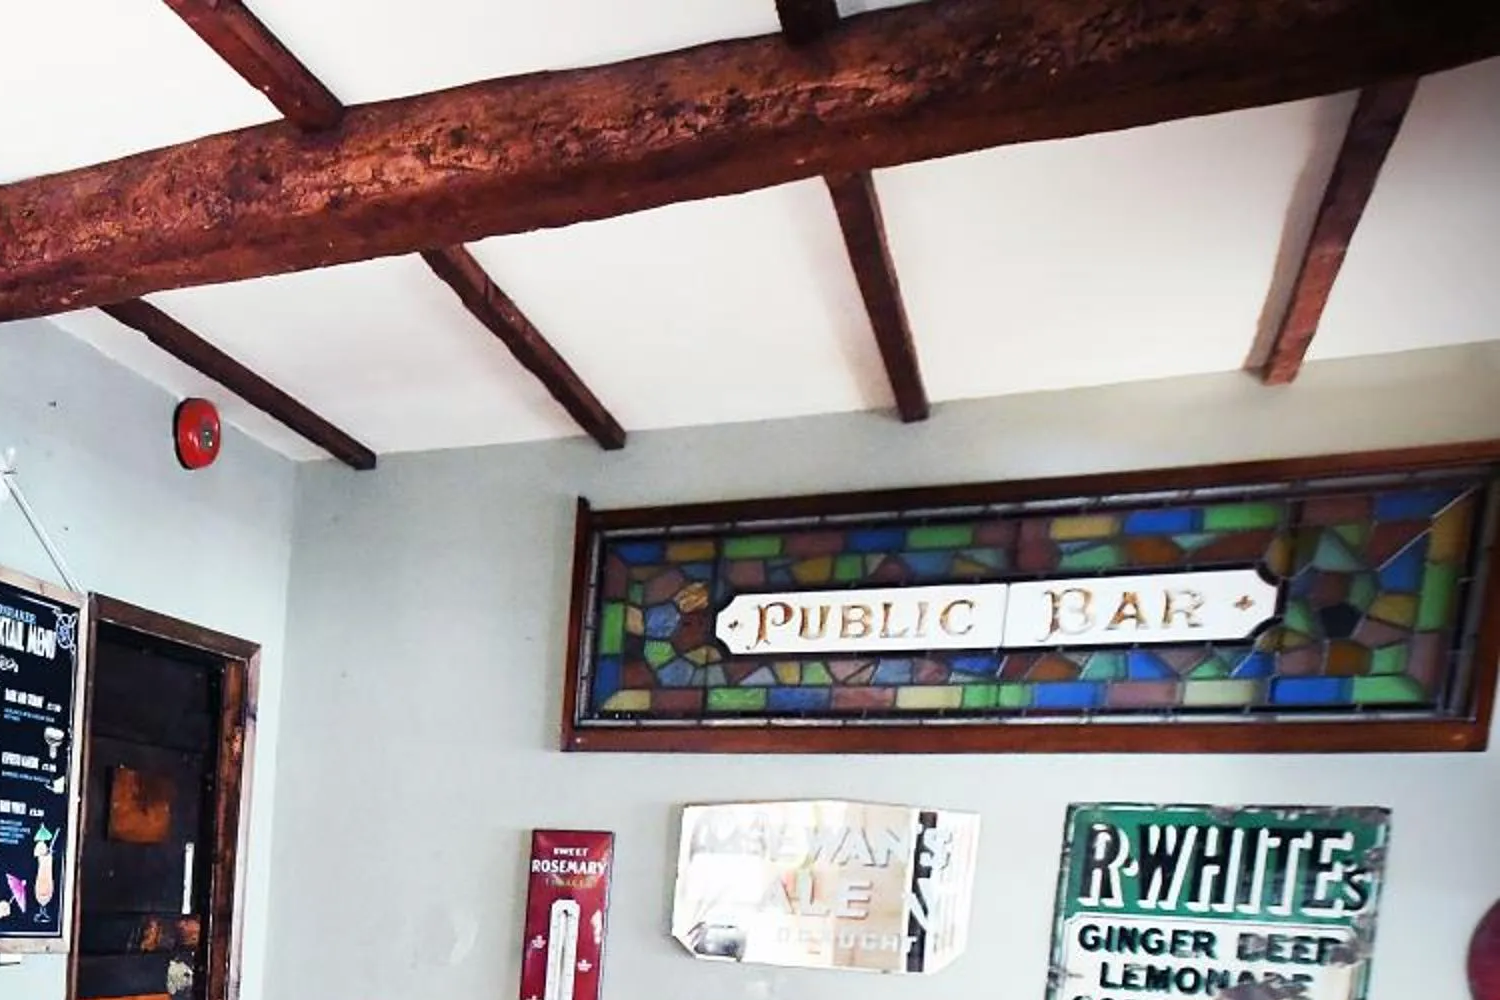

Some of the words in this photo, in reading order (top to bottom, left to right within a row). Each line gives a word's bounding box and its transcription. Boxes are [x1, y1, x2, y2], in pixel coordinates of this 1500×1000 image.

[746, 599, 977, 650] PUBLIC
[1035, 587, 1206, 643] BAR
[531, 859, 608, 876] ROSEMARY
[1077, 923, 1219, 962] GINGER
